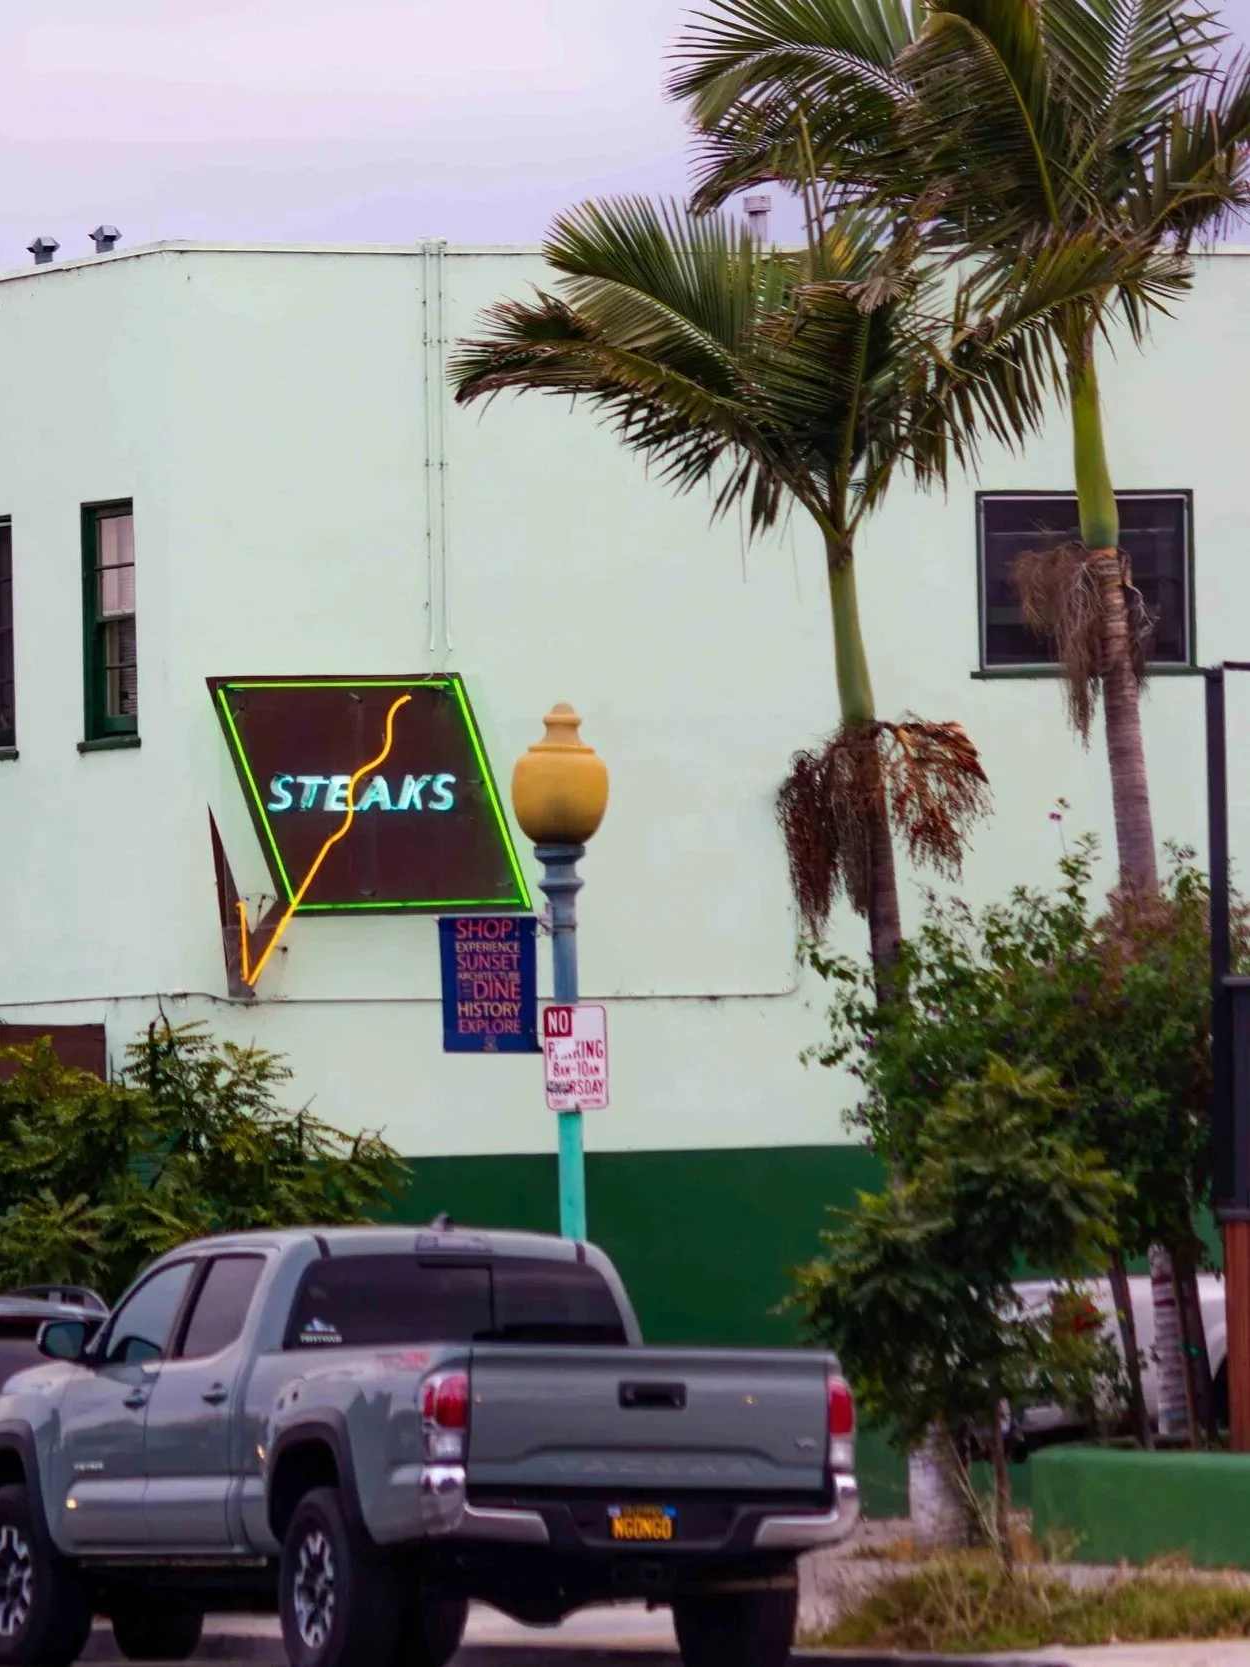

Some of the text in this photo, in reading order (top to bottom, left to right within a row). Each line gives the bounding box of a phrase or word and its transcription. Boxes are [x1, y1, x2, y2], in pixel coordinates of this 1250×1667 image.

[267, 772, 457, 813] STEAKS
[455, 941, 521, 953] EXPERIENCE
[456, 954, 521, 971] SUNSET
[473, 980, 521, 1000] DINE
[457, 1001, 522, 1018] HISTORY
[458, 1019, 522, 1034] EXPLORE
[547, 1009, 569, 1034] NO
[547, 1039, 604, 1060] PKING
